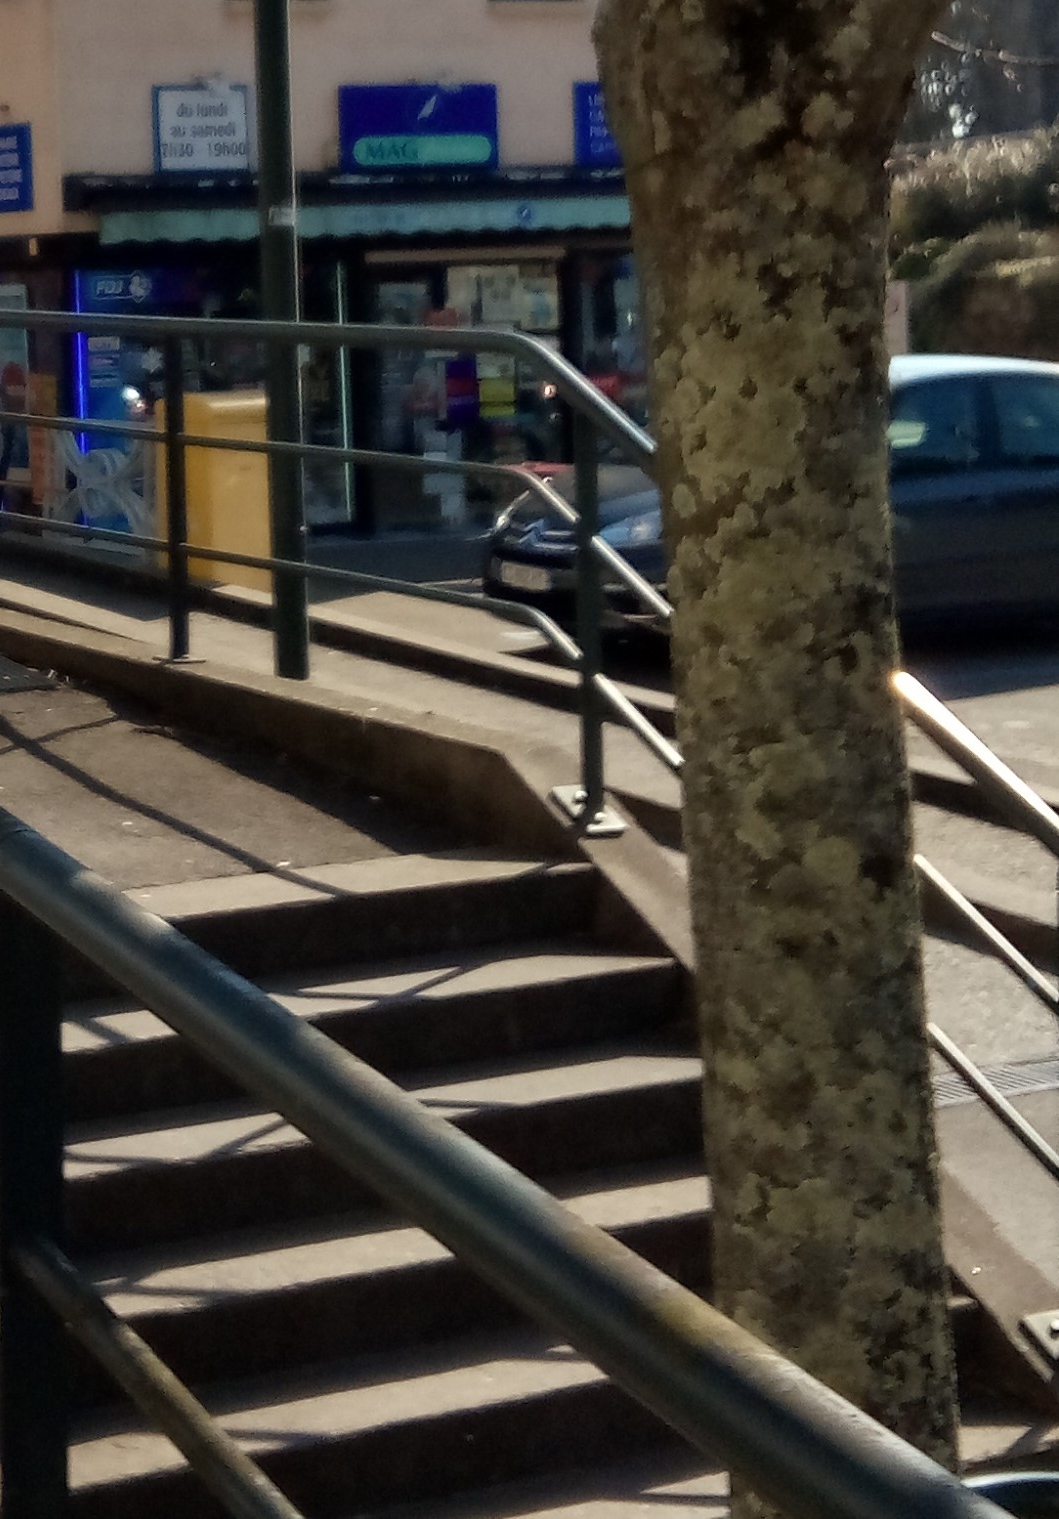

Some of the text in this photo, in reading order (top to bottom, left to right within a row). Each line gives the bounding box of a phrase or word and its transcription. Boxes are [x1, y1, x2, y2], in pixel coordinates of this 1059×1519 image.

[176, 102, 228, 118] du lundi
[170, 122, 236, 138] au samedi
[206, 142, 246, 158] 19h00
[96, 279, 124, 296] FDJ
